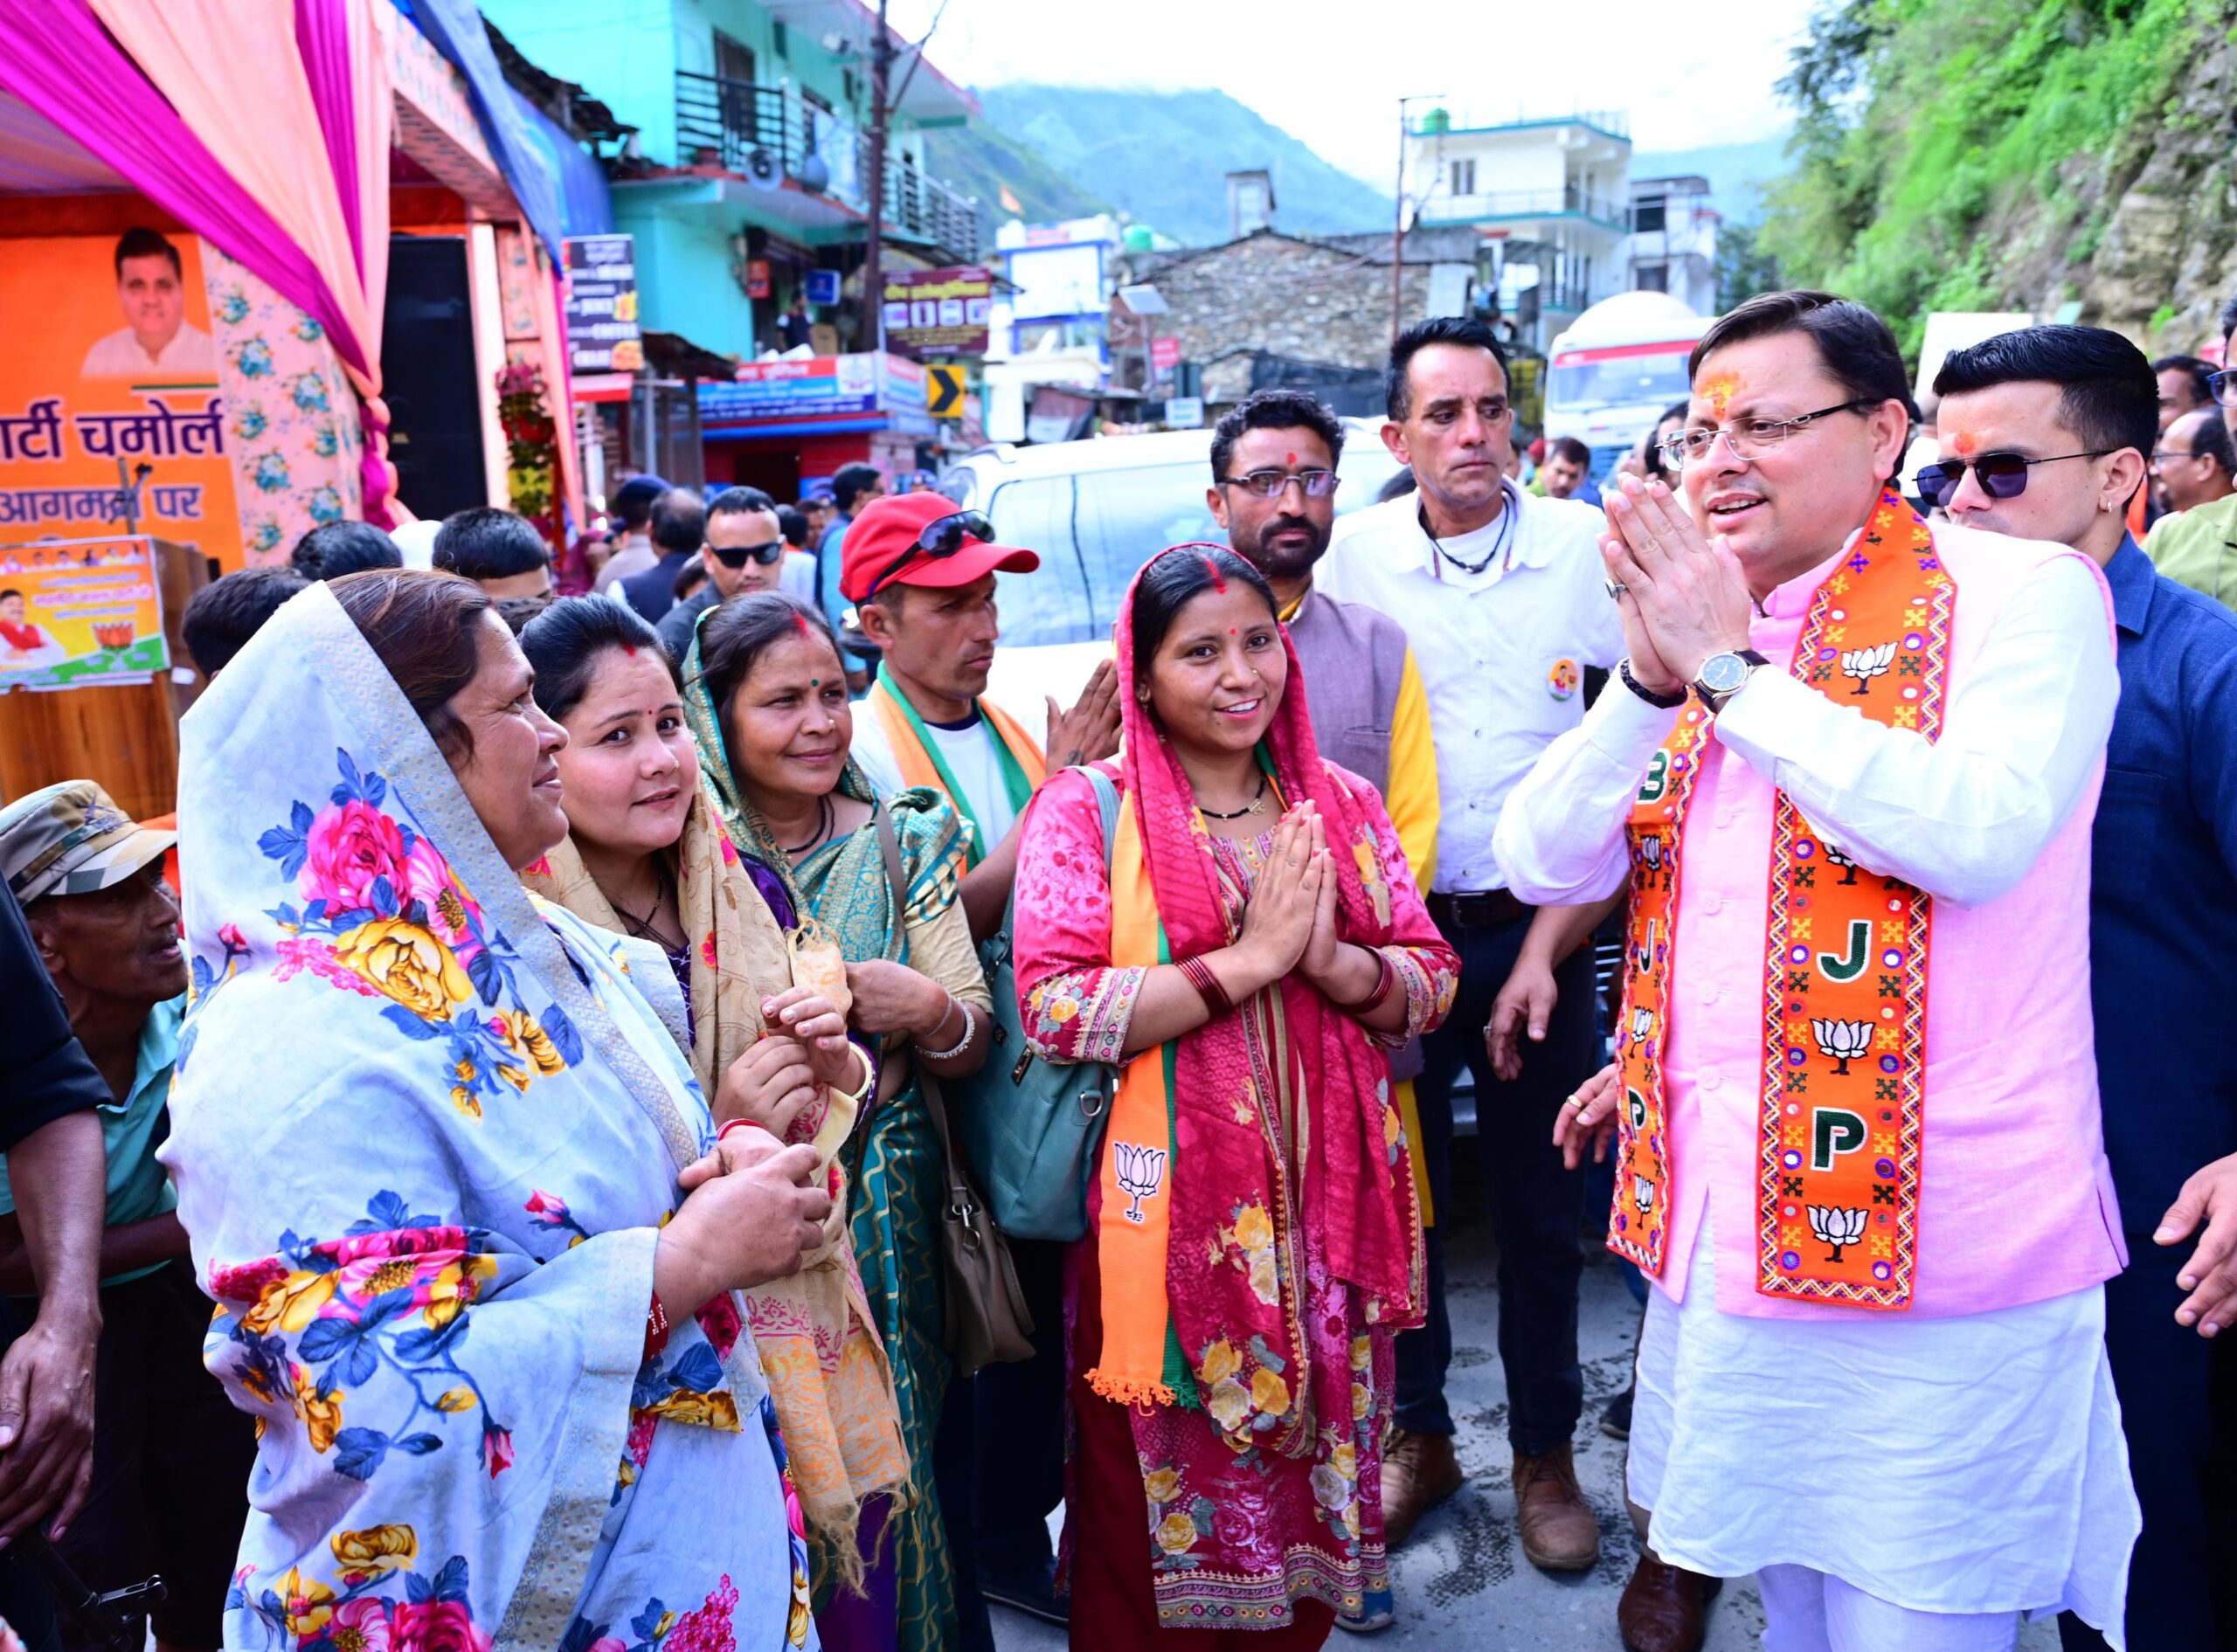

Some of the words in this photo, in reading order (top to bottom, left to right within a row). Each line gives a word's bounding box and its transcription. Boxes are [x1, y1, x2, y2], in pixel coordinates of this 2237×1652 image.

[0, 399, 61, 460] ार्टी
[153, 486, 200, 517] पर
[1817, 920, 1873, 983] J
[1811, 1106, 1867, 1172] P
